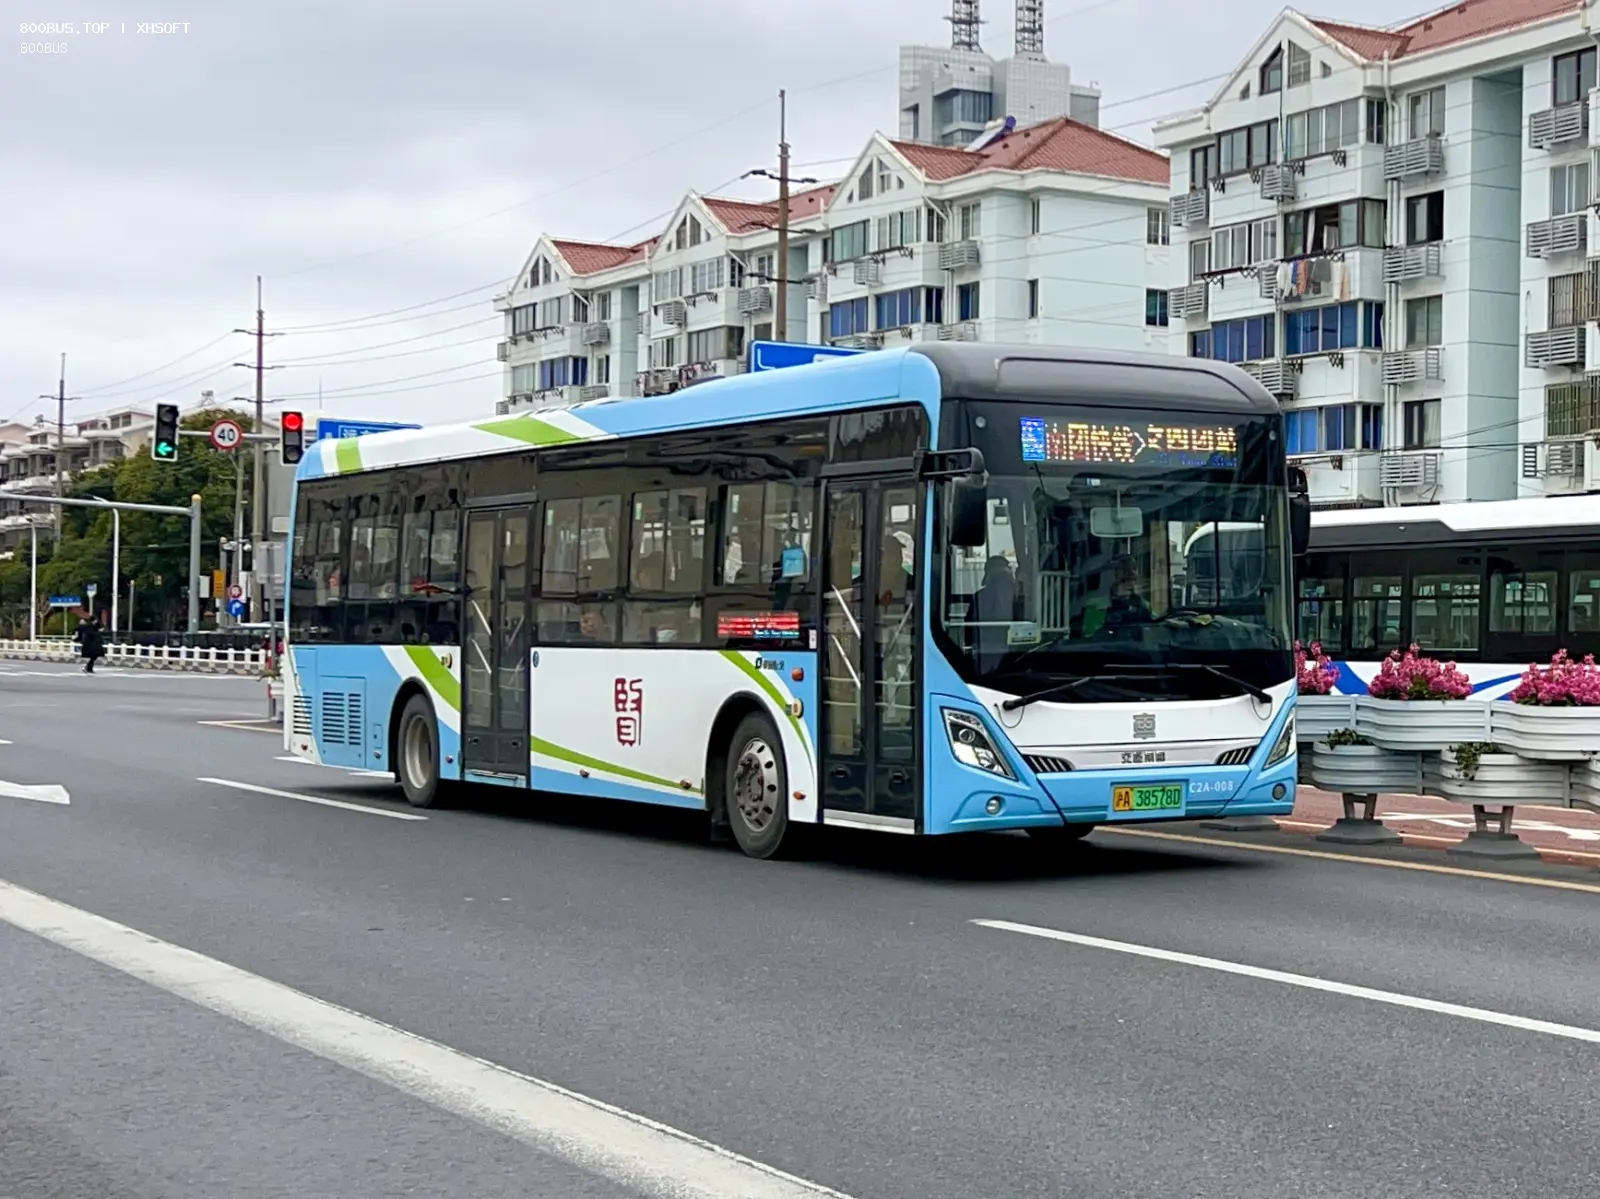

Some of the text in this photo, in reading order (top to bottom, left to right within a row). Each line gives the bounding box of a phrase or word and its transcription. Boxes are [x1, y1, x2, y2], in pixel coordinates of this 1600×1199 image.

[217, 427, 234, 442] 40
[1189, 781, 1233, 793] C2A-008
[1135, 788, 1181, 807] 38578D
